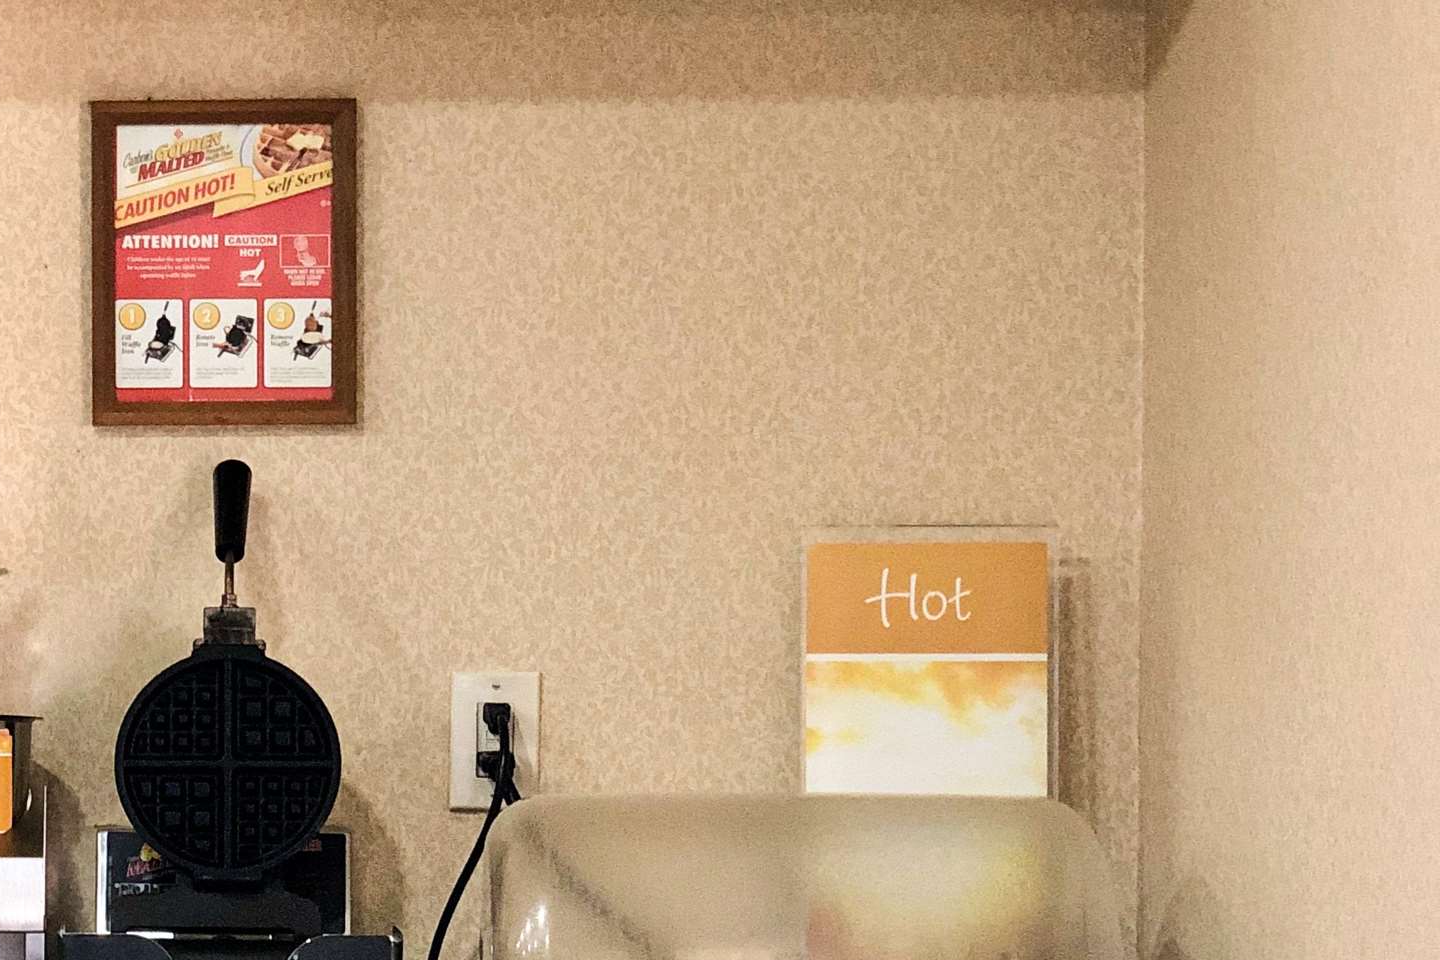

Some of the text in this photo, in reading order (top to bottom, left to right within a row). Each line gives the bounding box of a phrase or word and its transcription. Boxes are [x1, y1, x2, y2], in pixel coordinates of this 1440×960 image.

[138, 151, 205, 181] MALTED
[265, 174, 295, 196] Self
[115, 172, 236, 221] CAUTION HOT!
[121, 233, 219, 249] ATTENTION!
[227, 236, 275, 245] CAUTION
[239, 248, 262, 257] HOT
[864, 567, 972, 628] Hot
